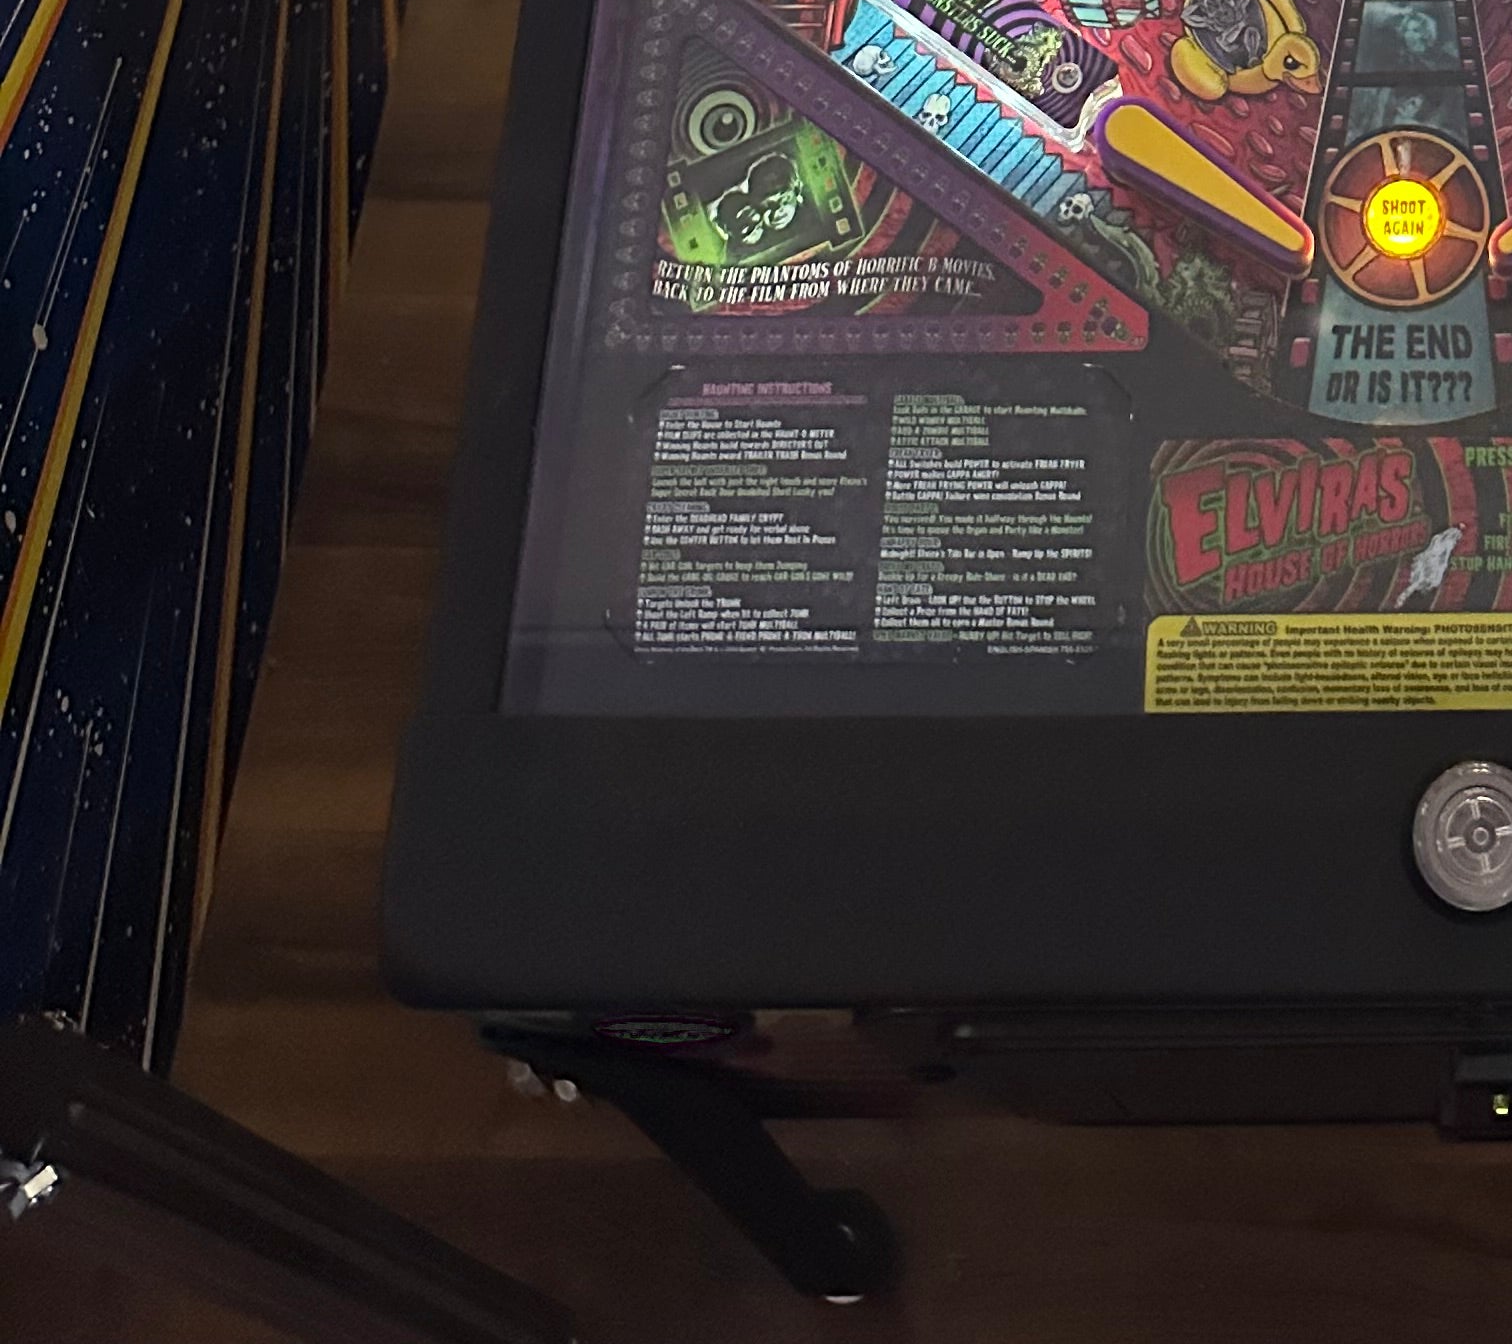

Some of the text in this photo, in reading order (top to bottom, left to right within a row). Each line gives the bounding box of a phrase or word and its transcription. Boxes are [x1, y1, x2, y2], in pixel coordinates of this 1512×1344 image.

[1381, 198, 1426, 218] SHOOT
[1383, 220, 1425, 237] AGAIN
[657, 256, 921, 285] RETURN THE PHANTOMS OF HORRIFIC
[653, 276, 929, 304] BACK TO THE FILM FROM WHERE THEY
[1331, 323, 1474, 361] THE END
[757, 381, 833, 395] INSTRUCTIONS
[1325, 369, 1474, 405] OR IS IT???
[1484, 534, 1510, 551] FIRE
[1450, 555, 1483, 572] STOP
[1224, 552, 1313, 602] HOUSE
[1202, 621, 1277, 636] WARNING
[1285, 625, 1341, 637] Important
[1343, 624, 1379, 635] Health
[1383, 624, 1430, 635] Warning:
